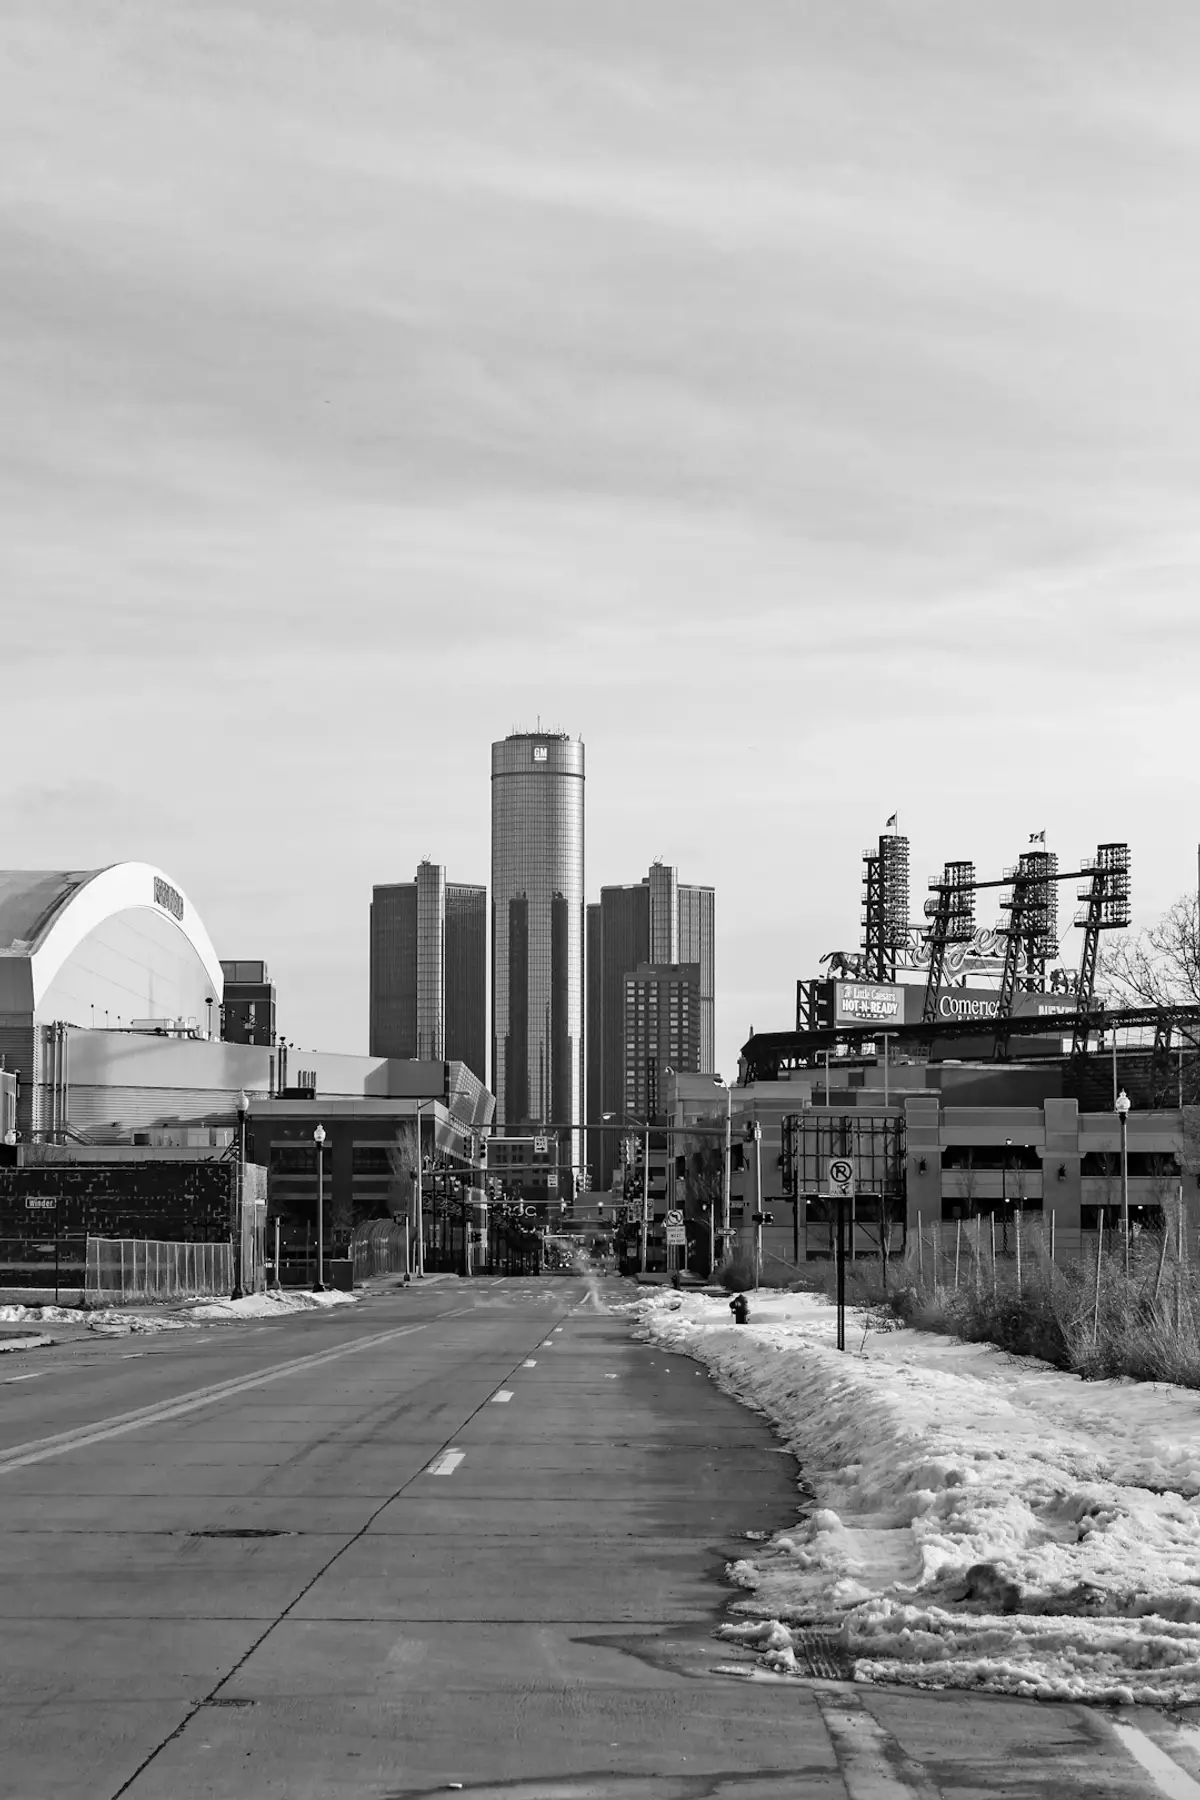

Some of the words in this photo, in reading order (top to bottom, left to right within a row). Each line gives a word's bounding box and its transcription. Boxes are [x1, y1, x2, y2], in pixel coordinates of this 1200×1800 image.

[534, 747, 548, 758] GM
[853, 987, 870, 1000] Little
[842, 999, 898, 1015] HOT-N-READY
